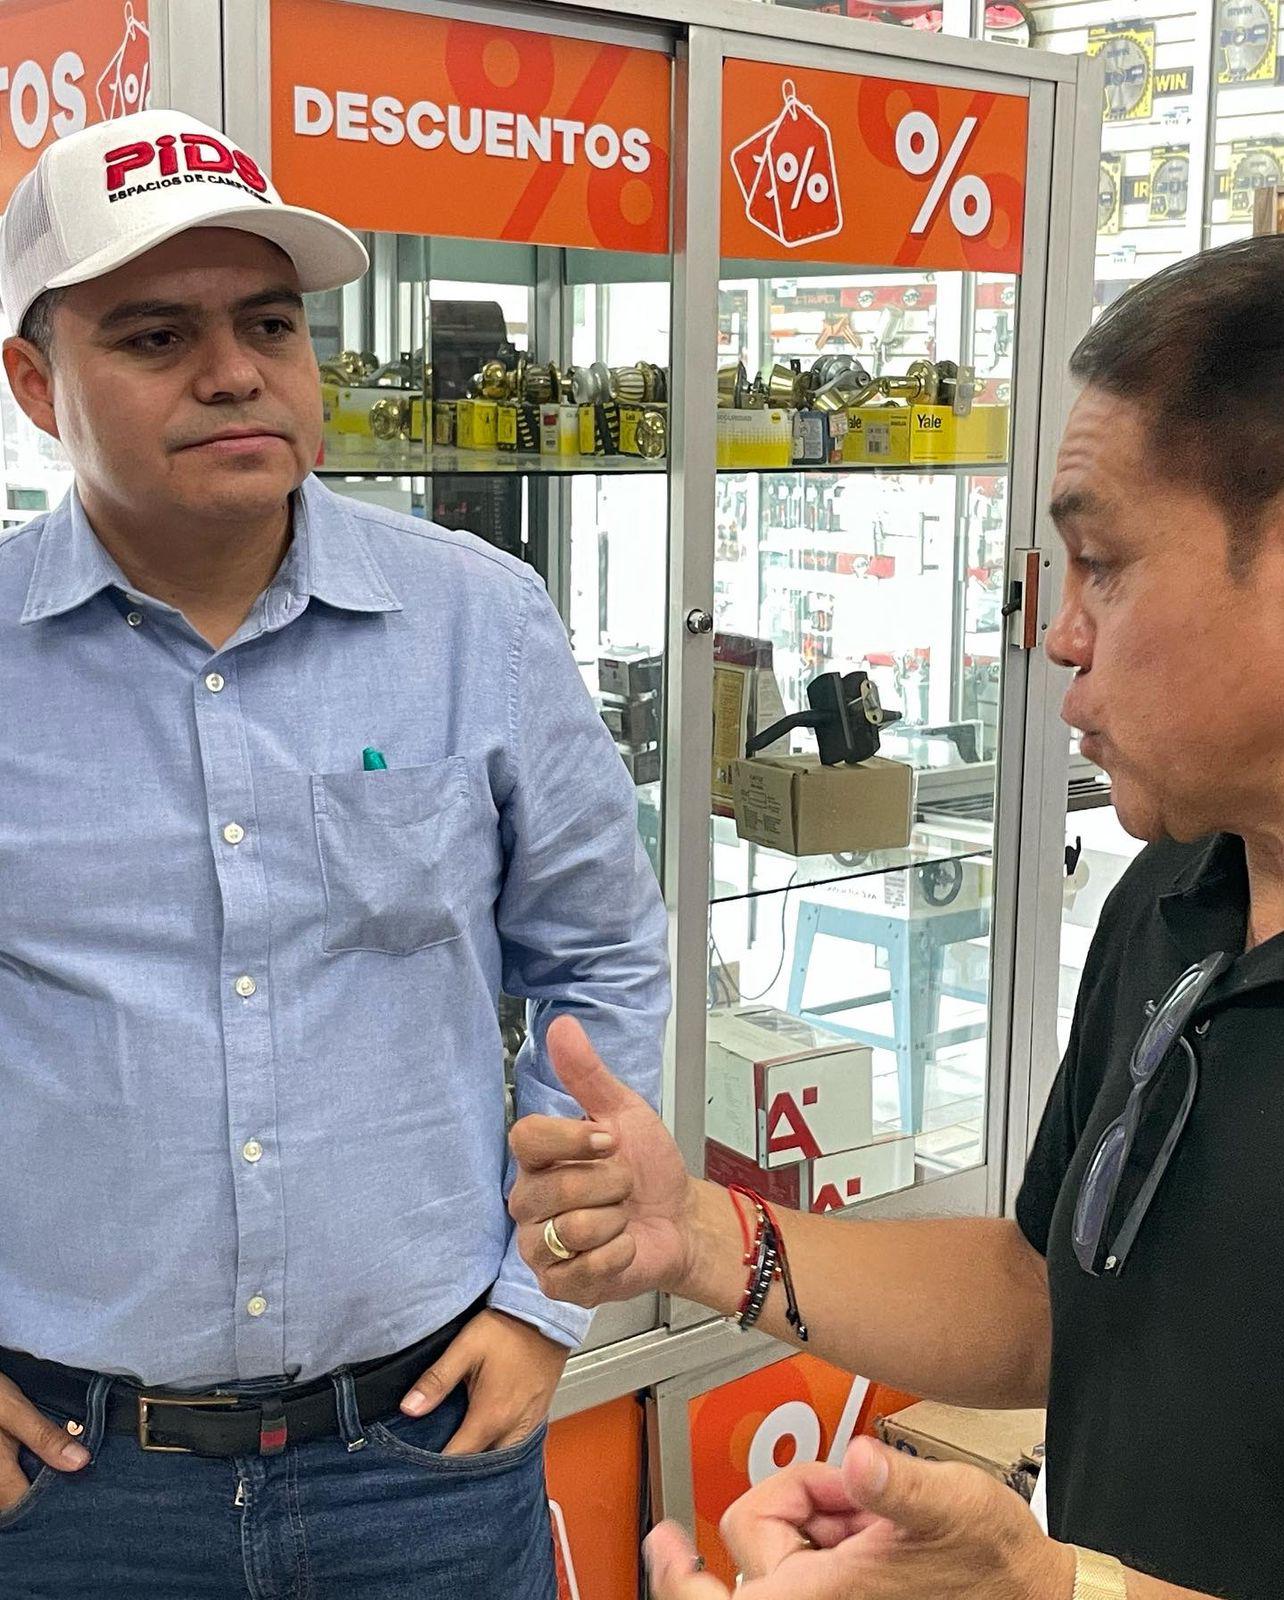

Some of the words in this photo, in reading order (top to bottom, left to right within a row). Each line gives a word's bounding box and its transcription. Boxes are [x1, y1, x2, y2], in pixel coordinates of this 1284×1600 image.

[0, 51, 87, 148] OS
[292, 85, 652, 173] DESCUENTOS
[108, 176, 182, 203] ESPACIOS
[183, 174, 205, 183] DE
[917, 413, 942, 429] Yale
